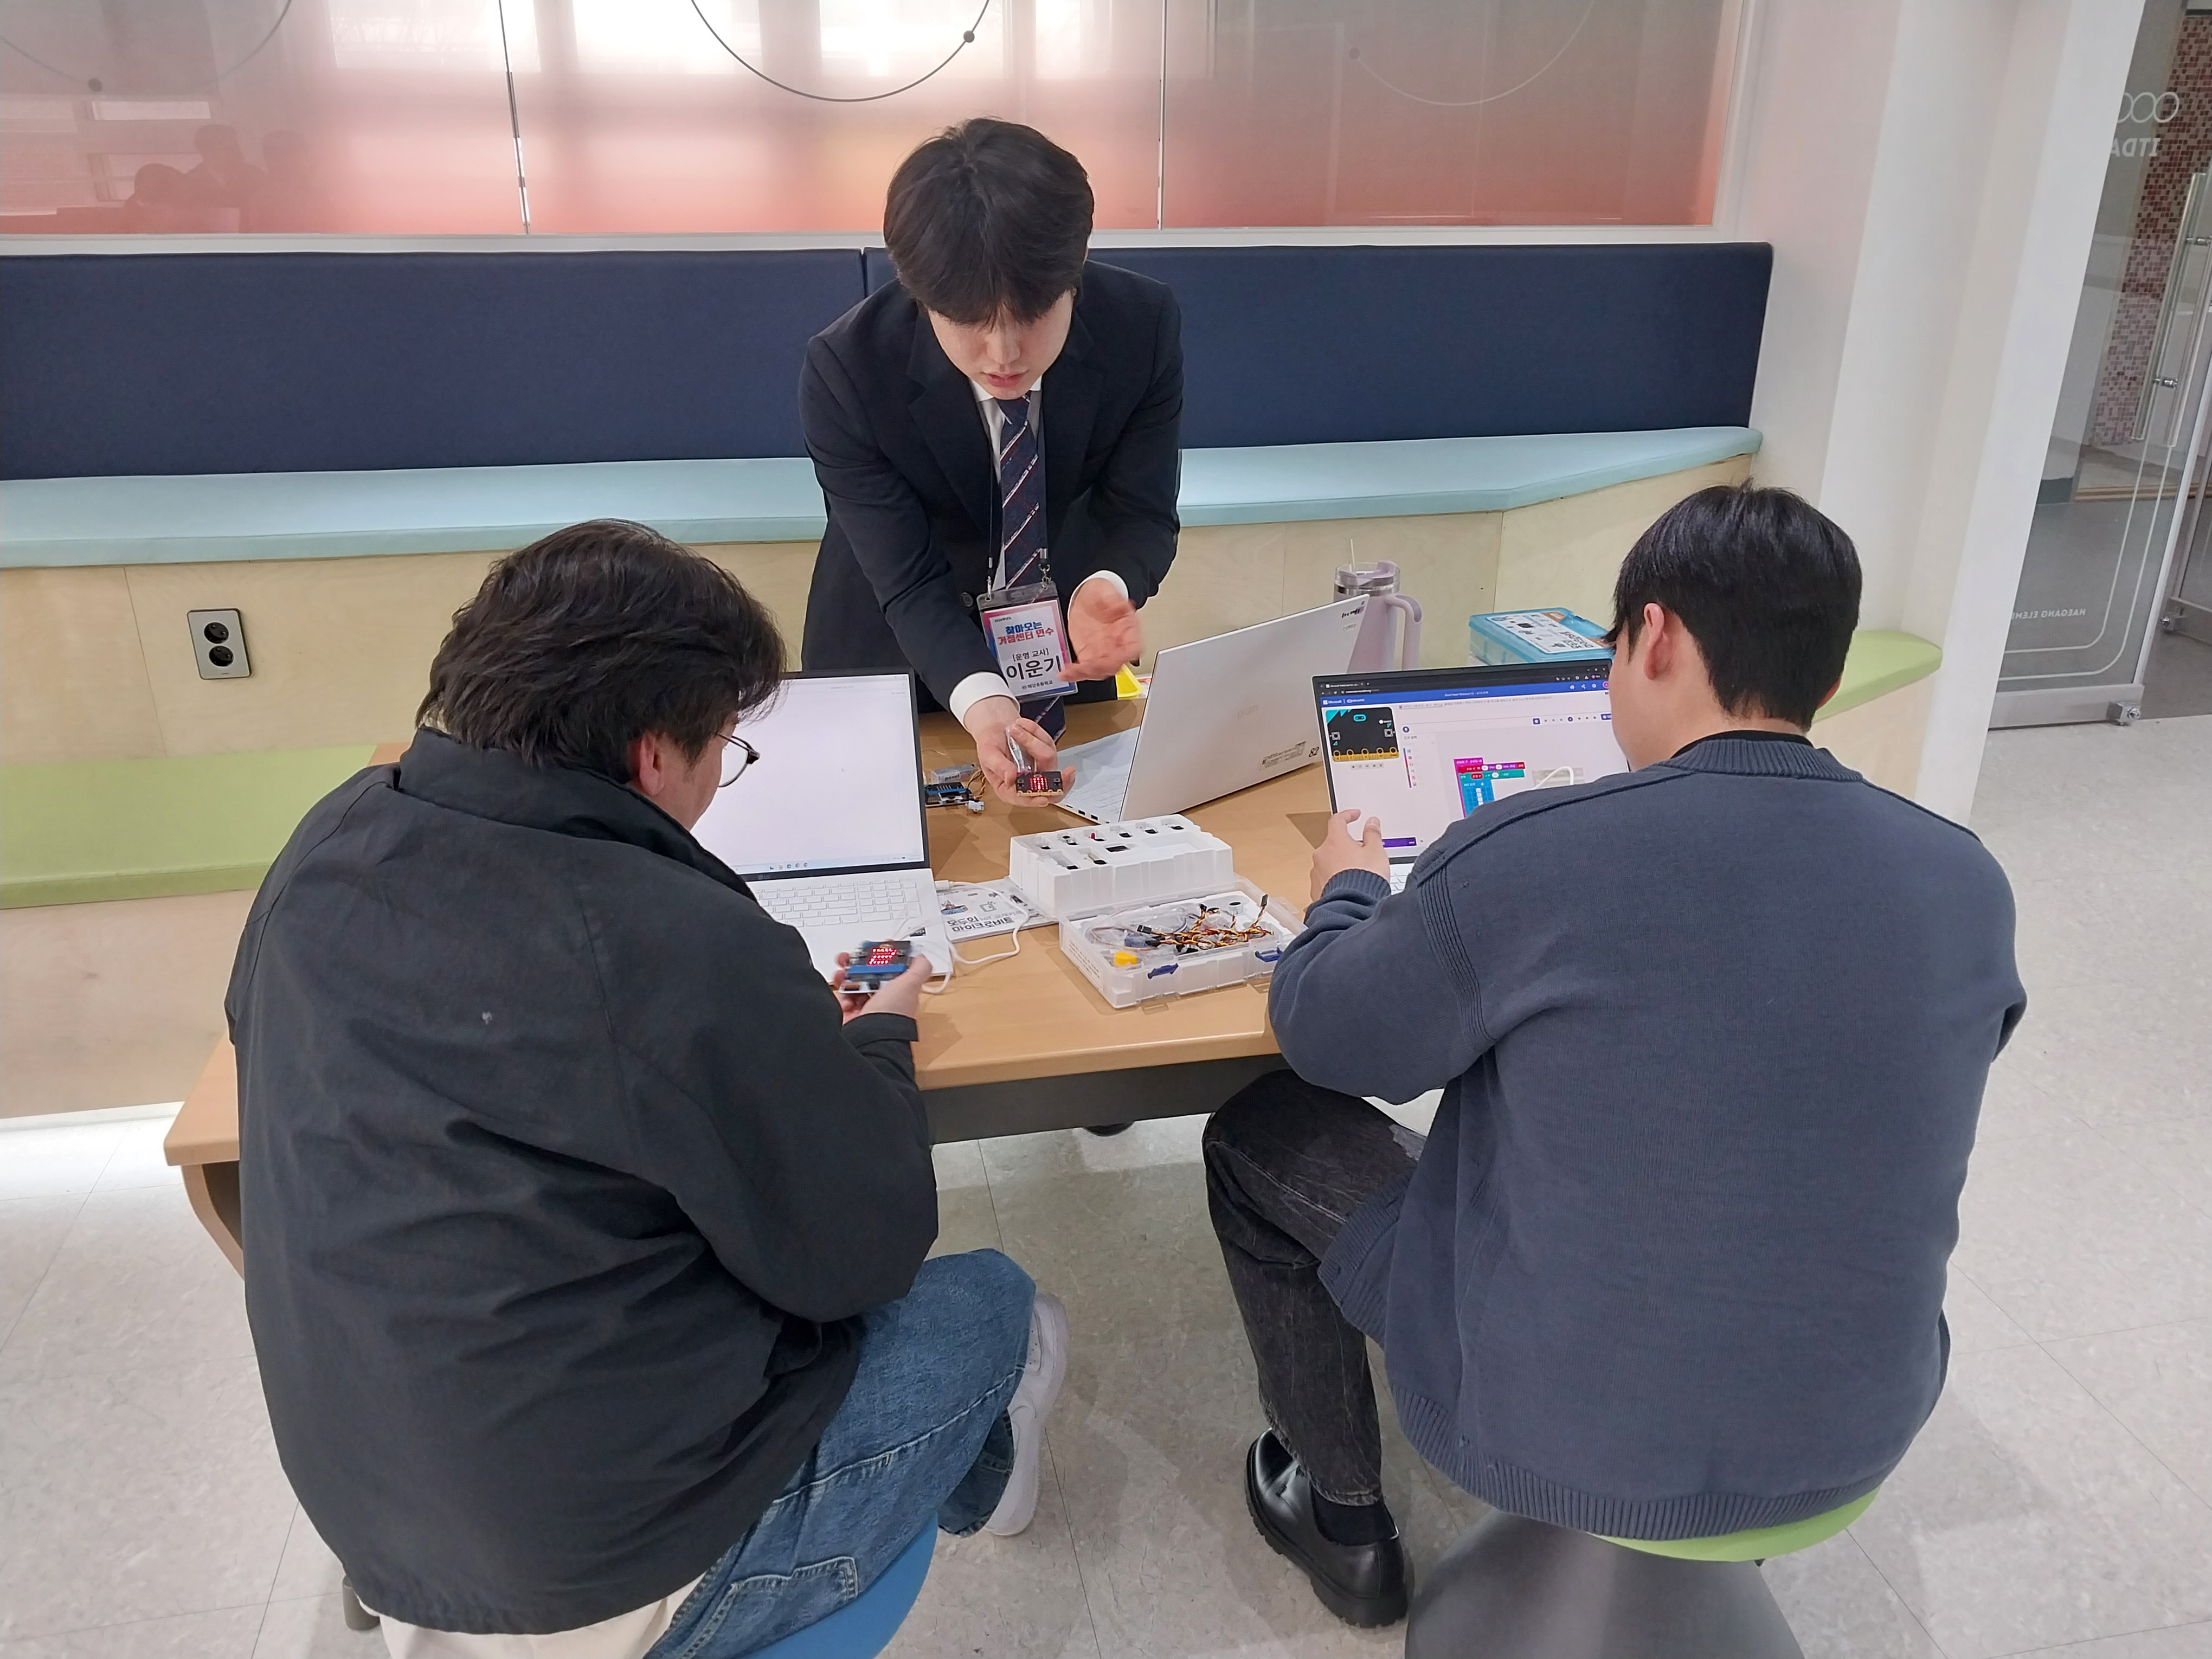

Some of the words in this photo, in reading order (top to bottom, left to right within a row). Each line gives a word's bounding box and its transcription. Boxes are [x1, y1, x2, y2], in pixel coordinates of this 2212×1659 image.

[1005, 622, 1042, 635] 찾아오는
[998, 631, 1033, 645] 거점센터
[1012, 652, 1030, 661] [운영
[1032, 648, 1049, 657] 교사]
[1006, 655, 1062, 680] 이운기
[1308, 747, 1320, 757] 82
[947, 916, 979, 926] 모두의
[951, 916, 1014, 932] 마이크로비트
